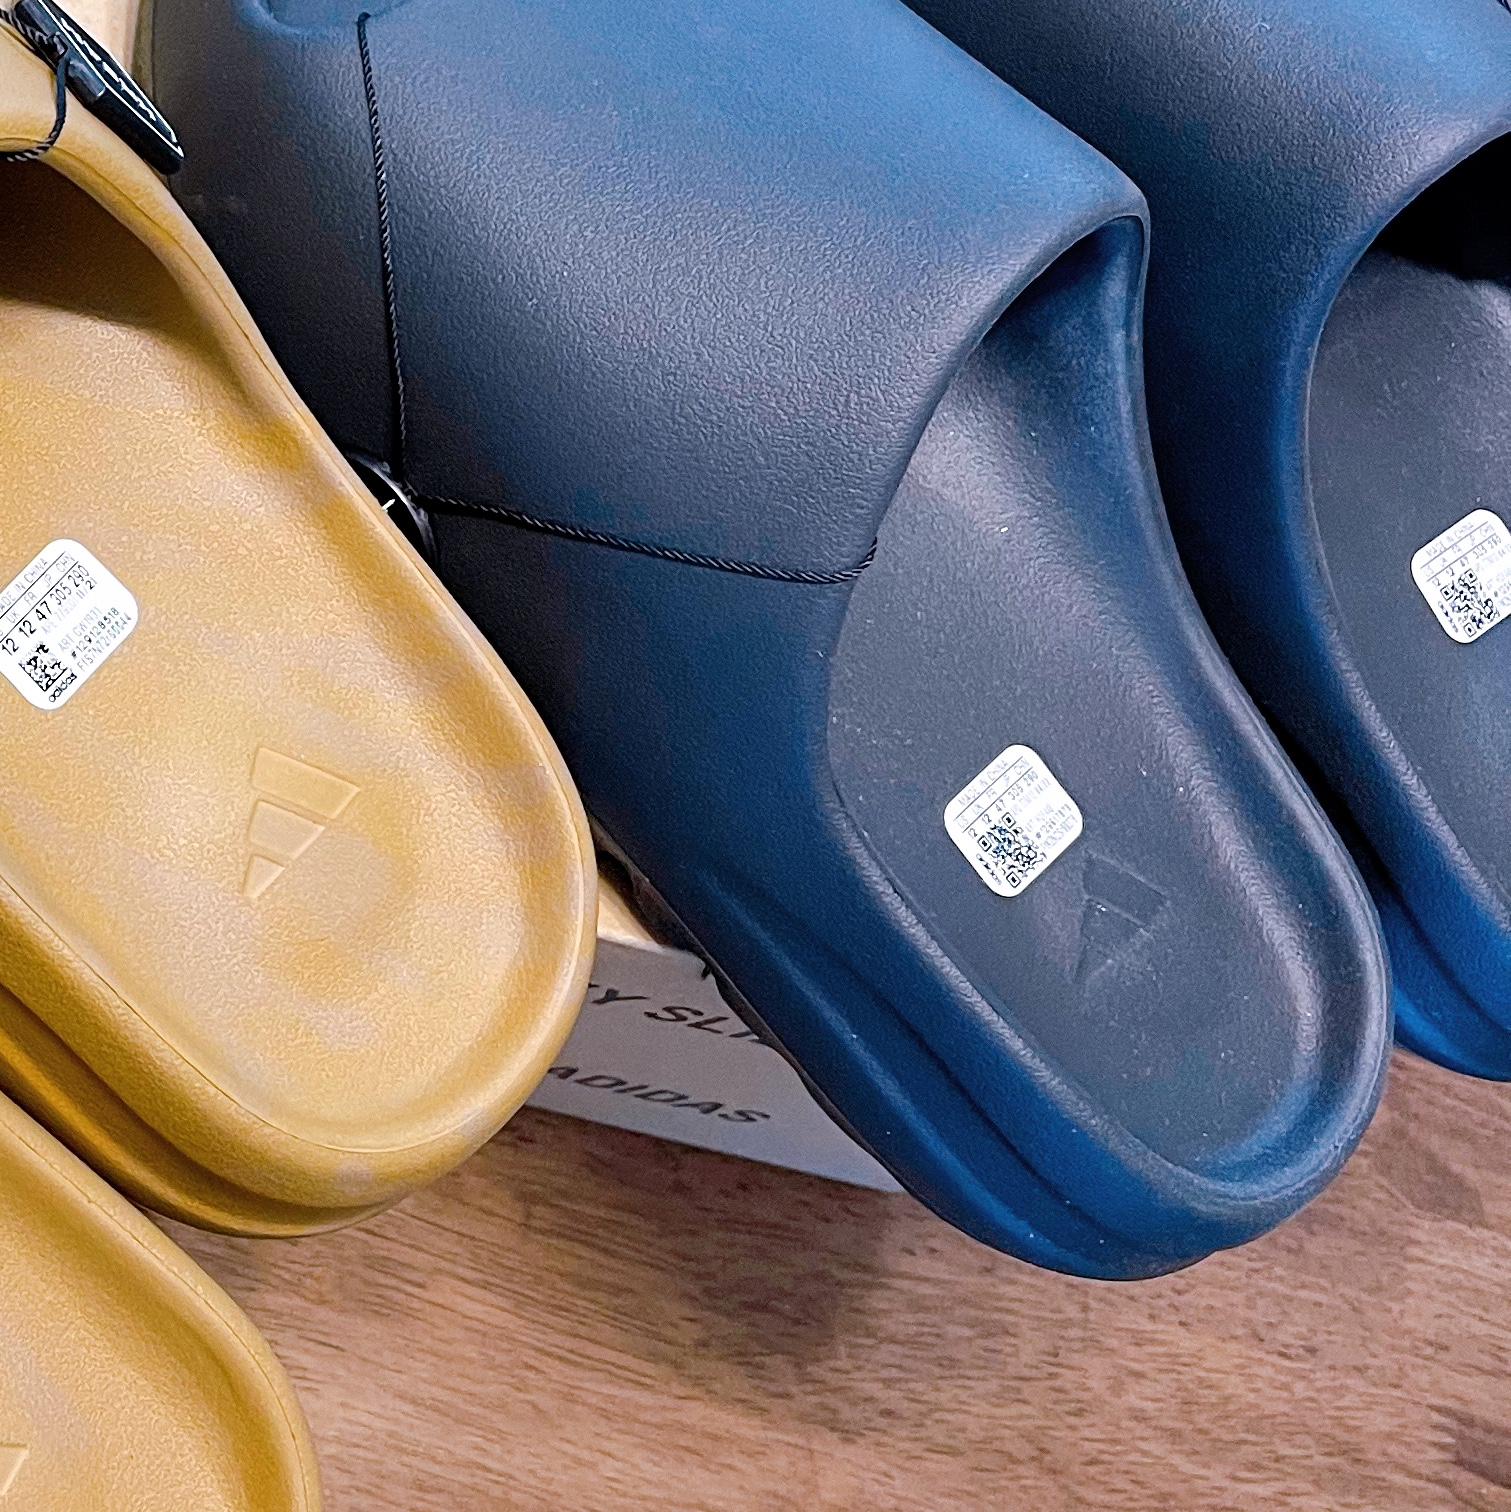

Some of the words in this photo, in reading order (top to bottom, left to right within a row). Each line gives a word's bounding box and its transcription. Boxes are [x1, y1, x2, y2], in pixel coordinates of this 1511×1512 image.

[13, 580, 26, 592] IN
[22, 557, 48, 584] CHINA
[54, 552, 75, 573] CHN
[0, 637, 19, 656] 12
[18, 619, 37, 638] 12
[34, 599, 52, 621] 47
[48, 581, 72, 606] 305
[66, 564, 89, 588] 290
